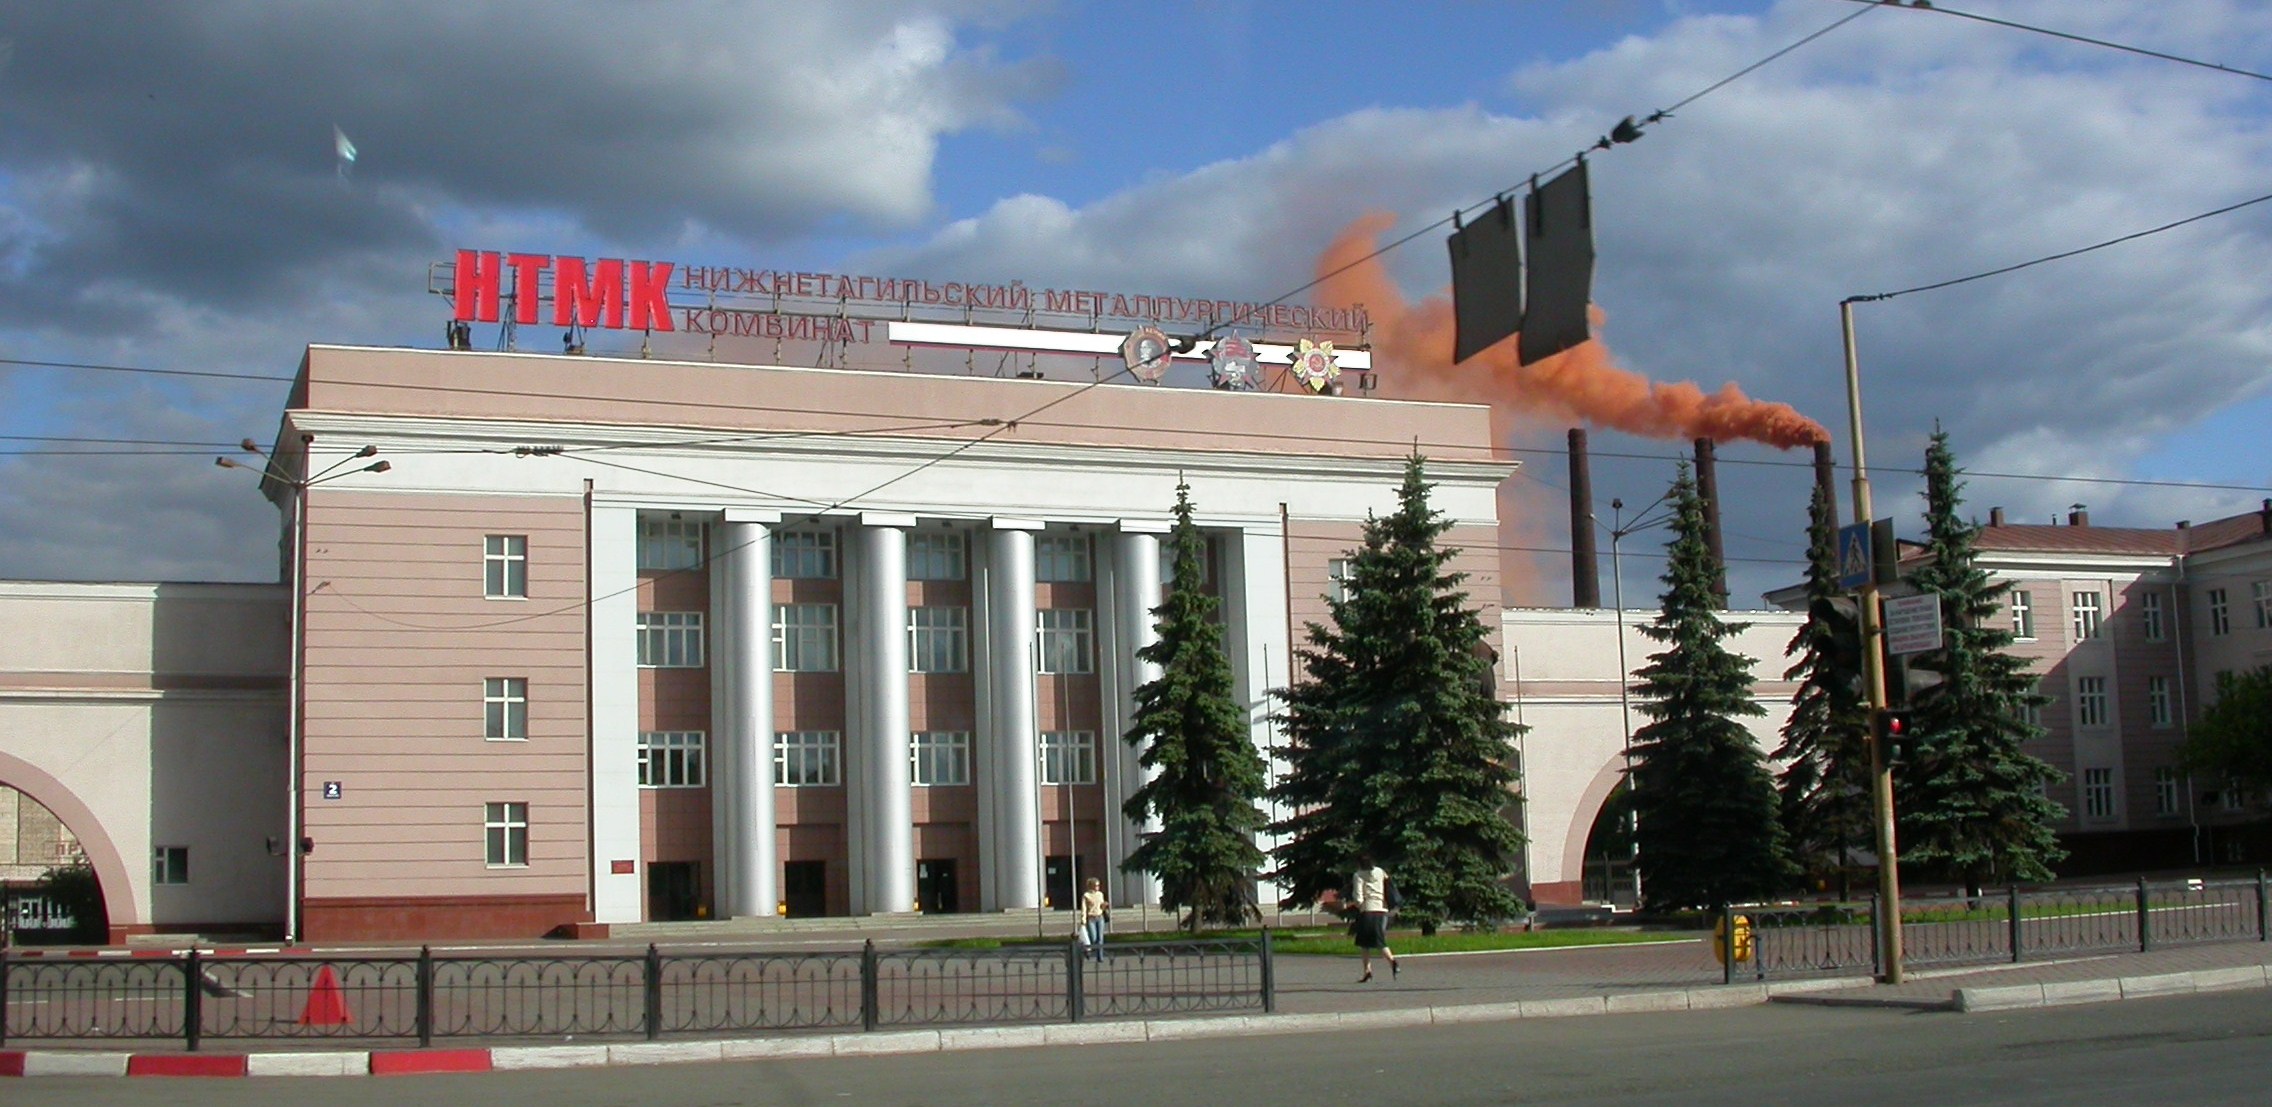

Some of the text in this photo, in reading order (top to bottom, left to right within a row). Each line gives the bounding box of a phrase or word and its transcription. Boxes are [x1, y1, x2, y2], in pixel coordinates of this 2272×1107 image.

[453, 248, 675, 332] НТМК
[684, 265, 1369, 332] НИЖНЕТАГИЛЬСКИЙ МЕТАЛЛУРГИЧЕСКИЙ
[684, 309, 875, 344] КОМБИНАТ
[328, 784, 338, 795] 2
